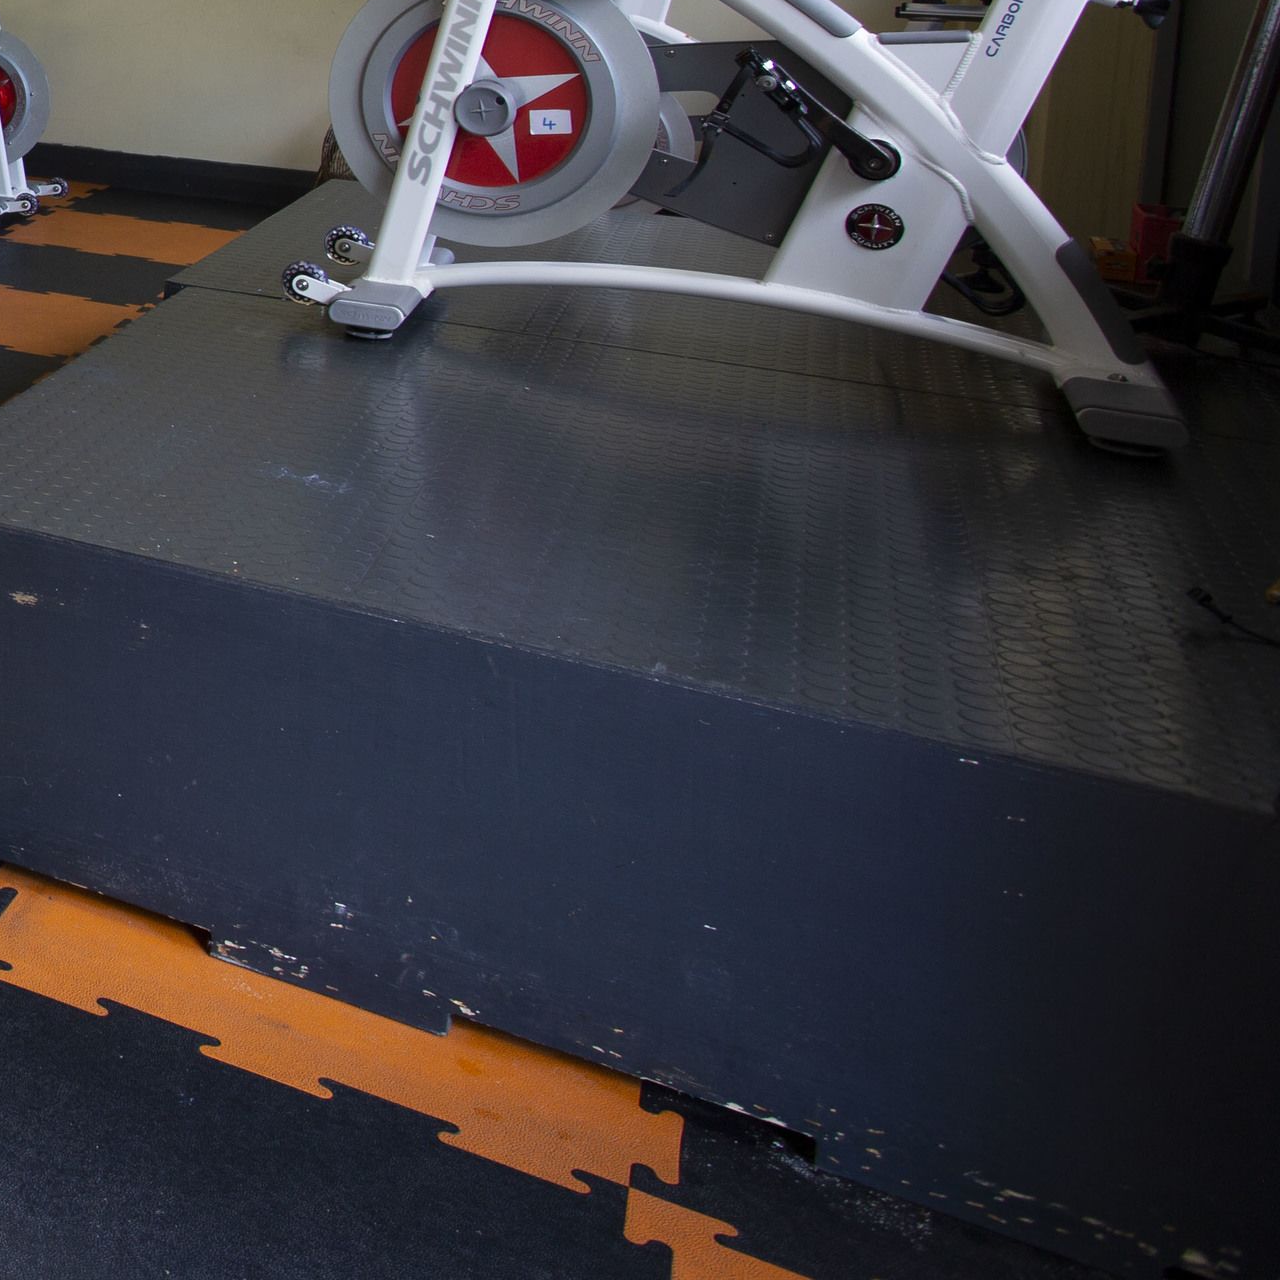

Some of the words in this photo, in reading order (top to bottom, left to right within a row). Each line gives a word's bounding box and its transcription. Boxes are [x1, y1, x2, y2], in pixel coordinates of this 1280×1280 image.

[542, 116, 556, 131] 4
[851, 205, 901, 227] SCHWINN
[851, 232, 895, 249] QUALITY
